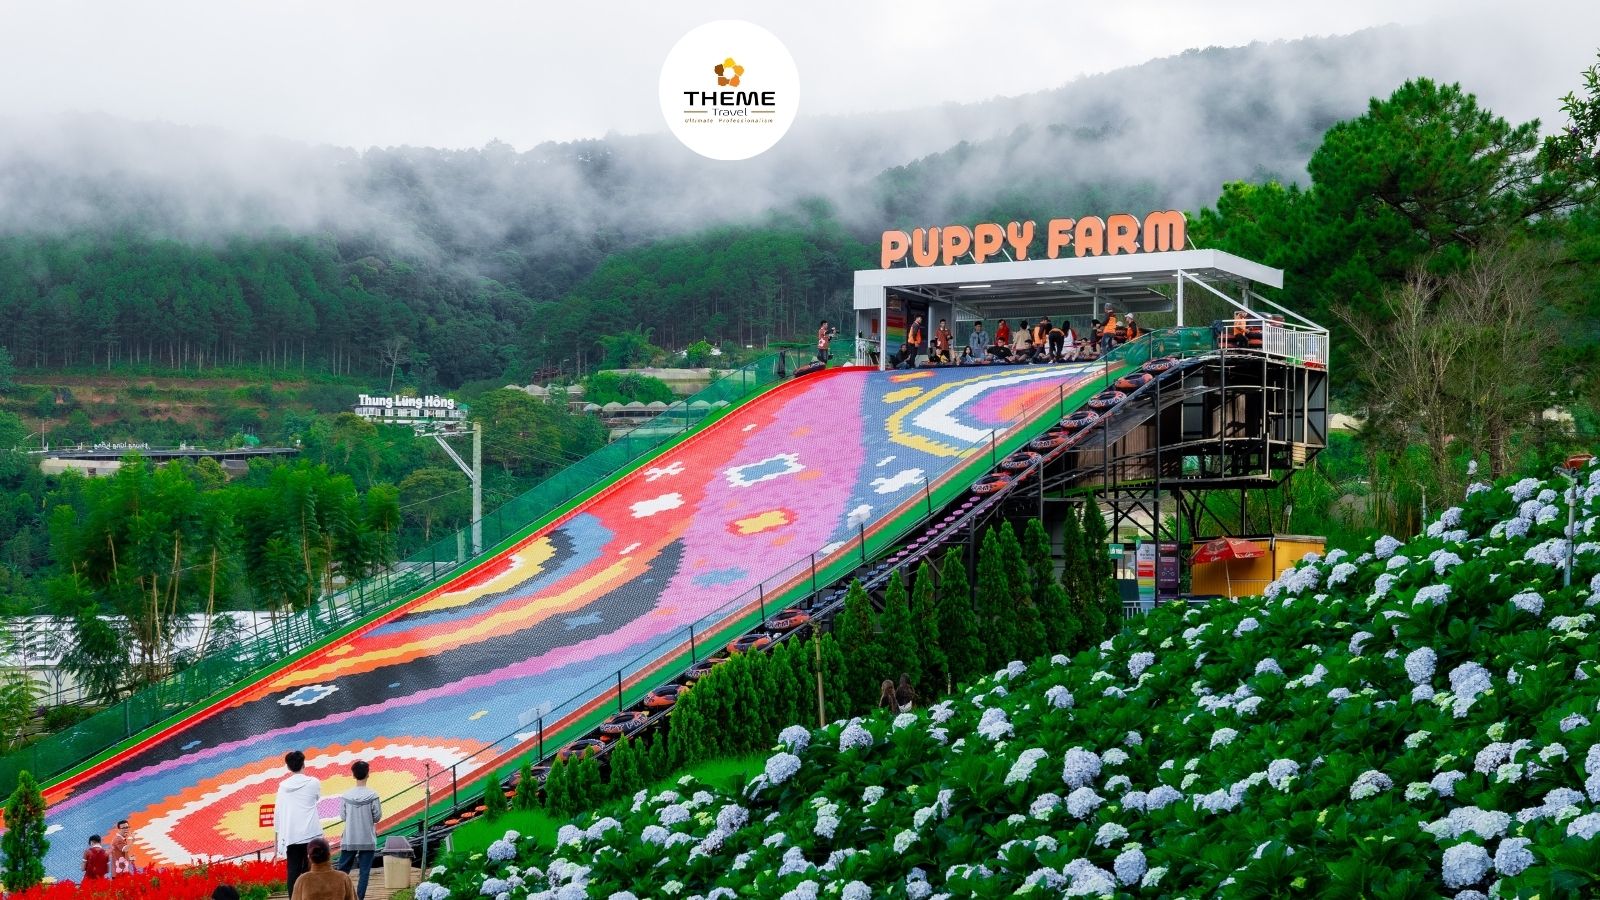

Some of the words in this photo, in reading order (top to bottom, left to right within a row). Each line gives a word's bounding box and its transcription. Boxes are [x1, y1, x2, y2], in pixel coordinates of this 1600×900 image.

[881, 220, 1036, 269] PUPPY
[1048, 210, 1187, 259] FARM
[358, 393, 393, 409] Thung
[424, 394, 455, 410] Hồng
